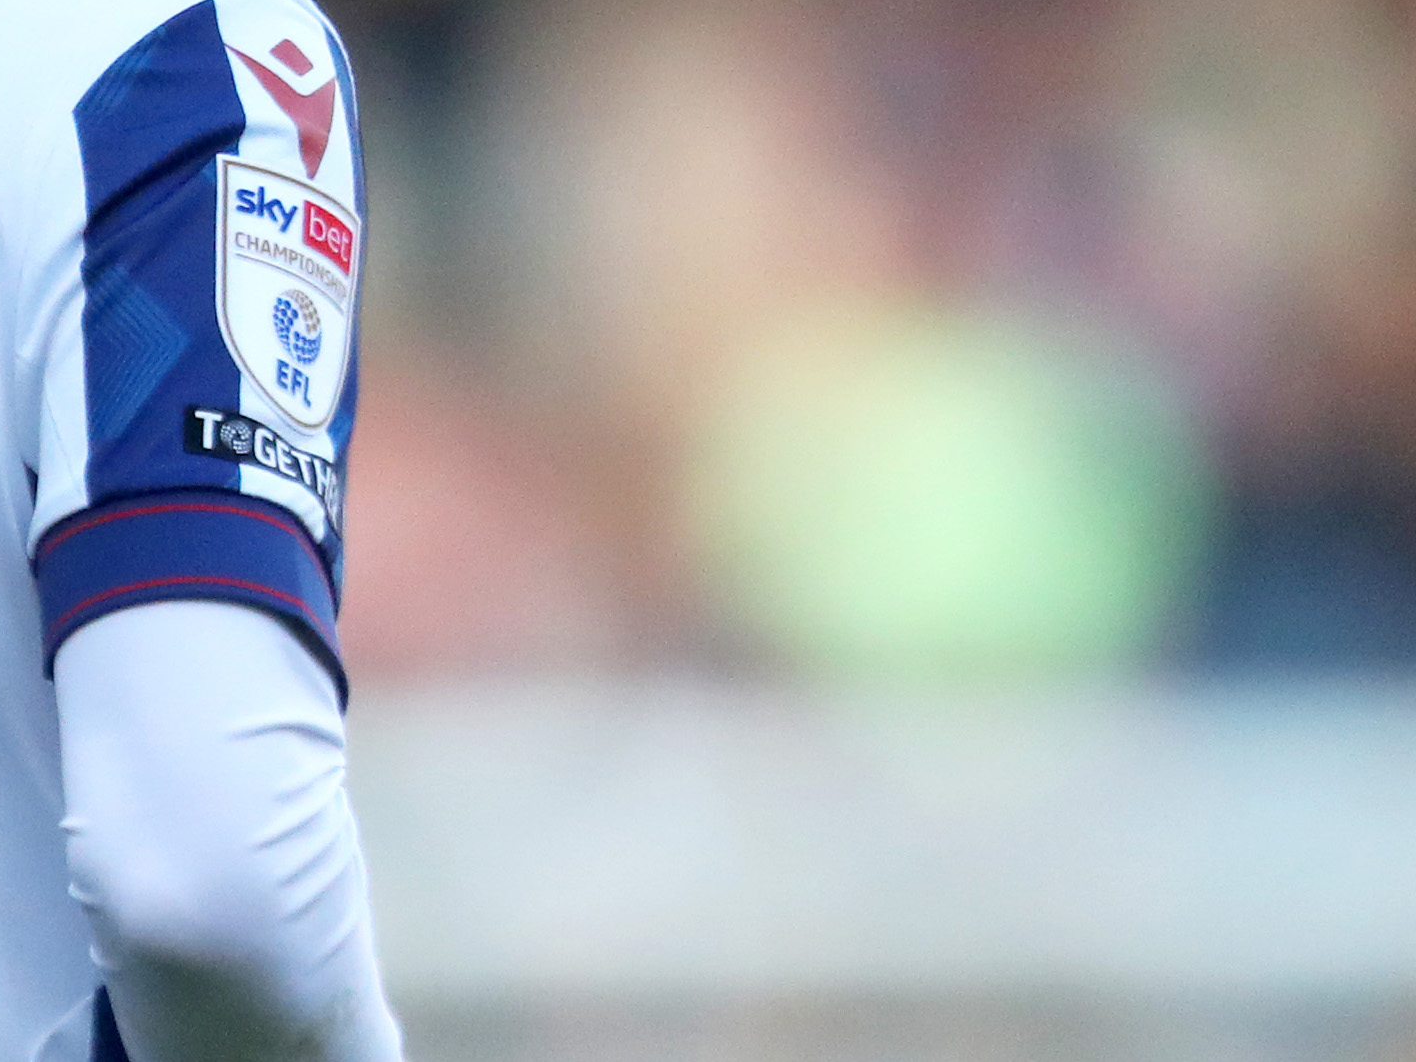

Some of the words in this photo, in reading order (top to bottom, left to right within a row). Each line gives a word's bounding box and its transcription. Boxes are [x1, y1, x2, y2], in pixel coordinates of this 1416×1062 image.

[235, 185, 298, 233] sky
[309, 206, 349, 262] bet
[276, 358, 311, 408] EFL
